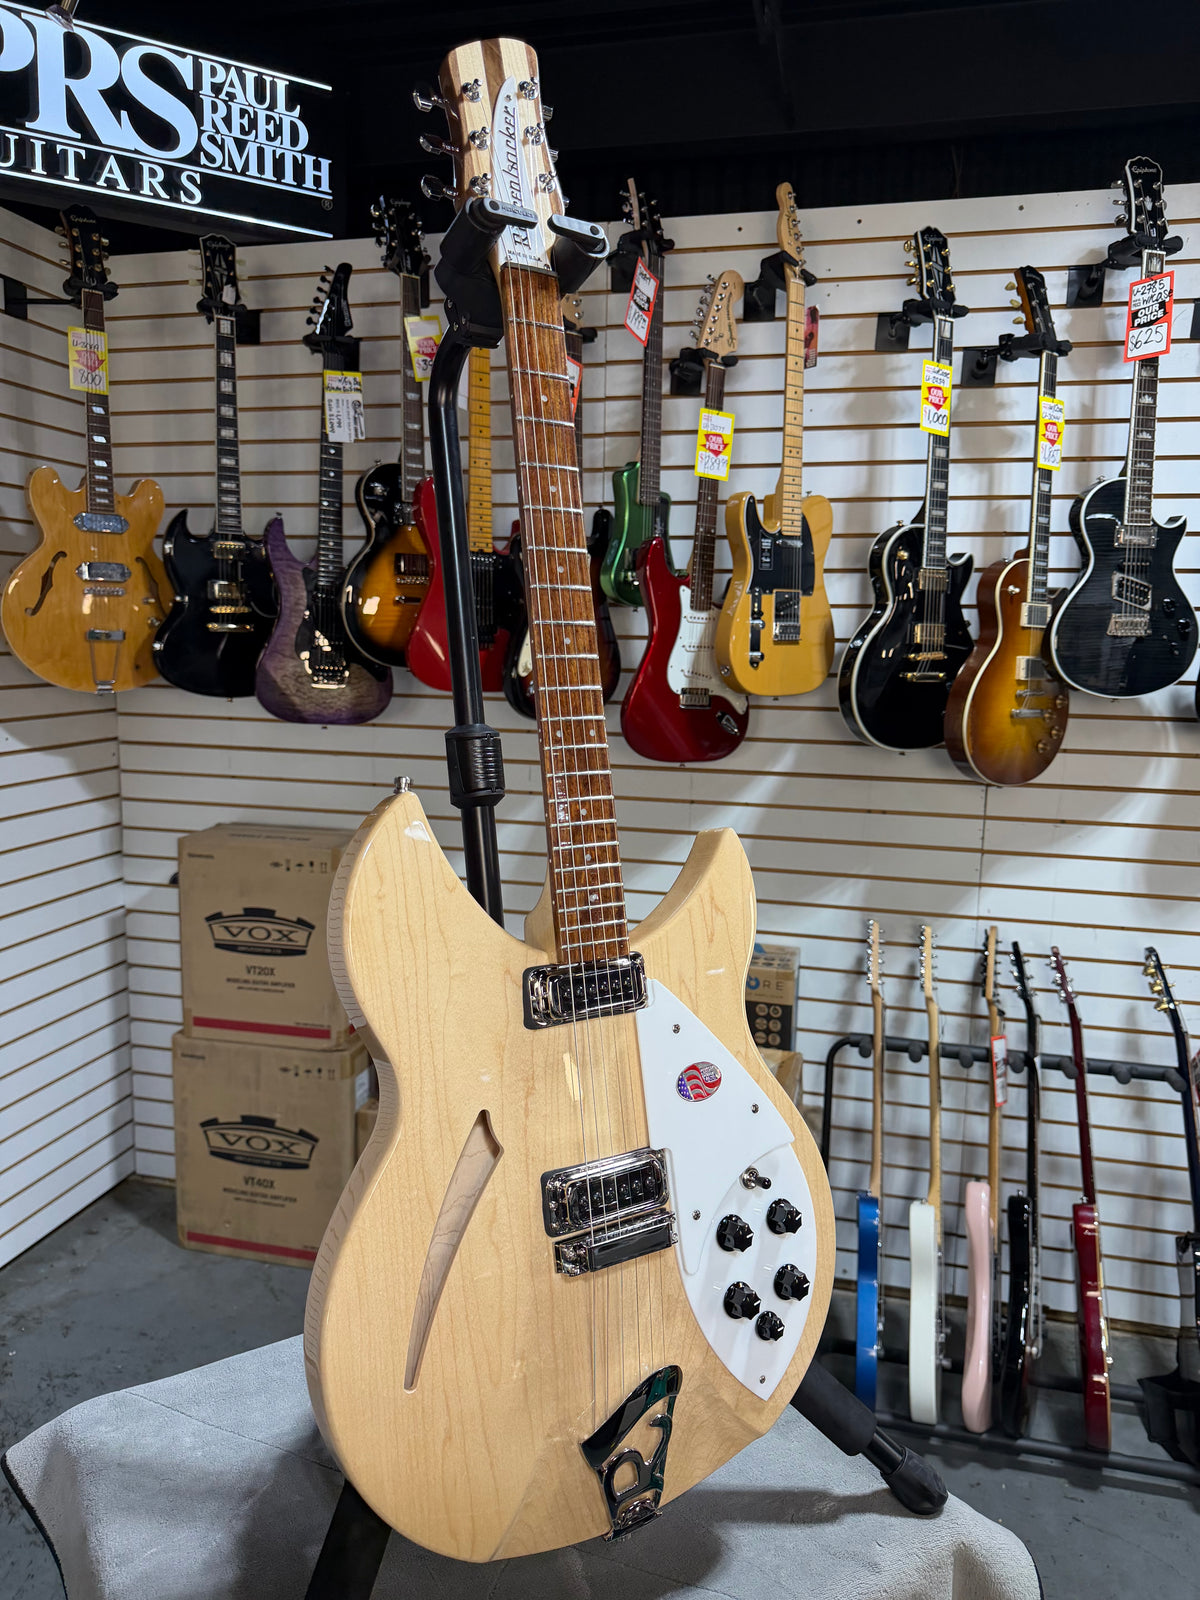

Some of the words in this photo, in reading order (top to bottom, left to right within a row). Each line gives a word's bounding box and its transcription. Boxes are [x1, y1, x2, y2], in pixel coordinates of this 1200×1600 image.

[199, 58, 300, 117] PAUL
[200, 95, 309, 151] REED
[200, 130, 332, 193] SMITH
[498, 106, 532, 250] Rienbacker
[1133, 309, 1165, 328] PRICE
[1137, 303, 1160, 318] OUR
[1129, 325, 1164, 352] $625
[928, 395, 945, 406] PRICE
[930, 387, 943, 398] OUR
[705, 442, 726, 452] PRICE
[708, 434, 723, 445] OUR
[218, 925, 300, 944] VOX
[213, 1131, 301, 1156] VOX
